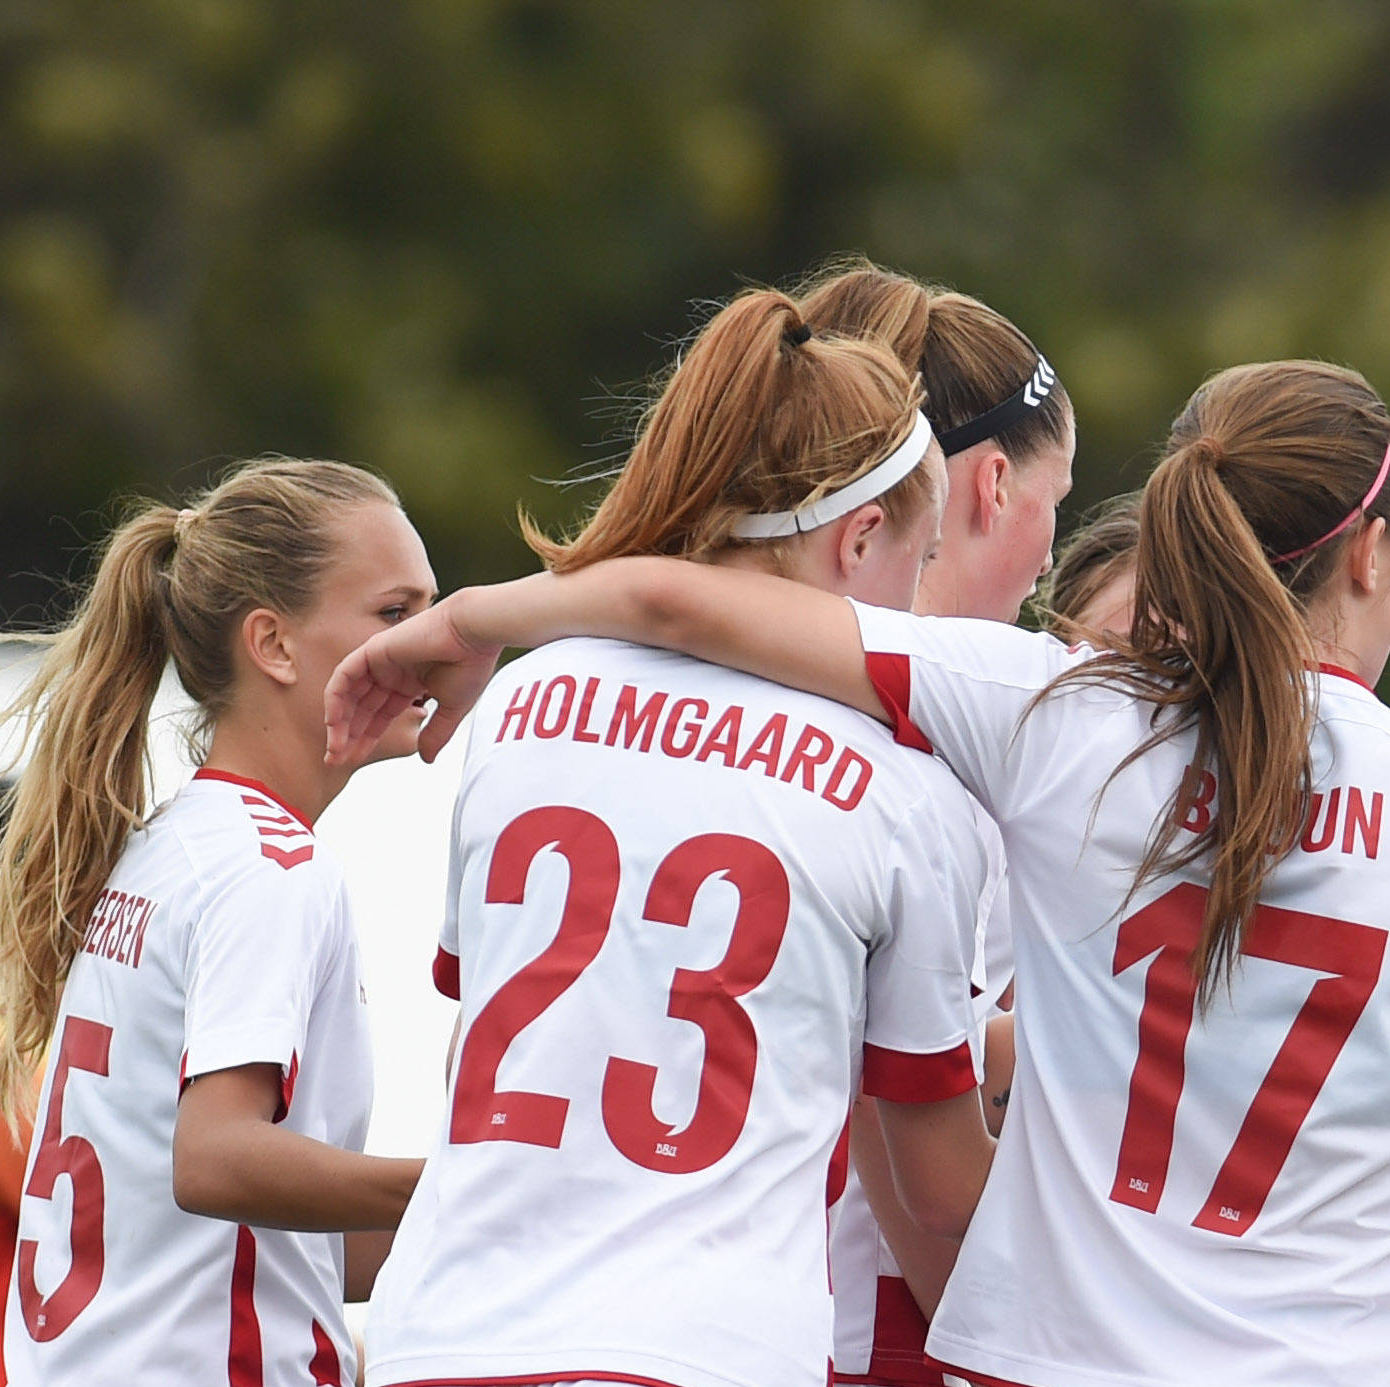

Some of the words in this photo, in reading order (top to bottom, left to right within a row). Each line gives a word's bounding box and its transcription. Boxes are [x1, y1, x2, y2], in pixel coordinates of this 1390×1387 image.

[493, 673, 874, 812] HOLMGAARD
[1173, 765, 1384, 860] BUN
[448, 804, 791, 1176] 23
[1108, 881, 1390, 1237] 17
